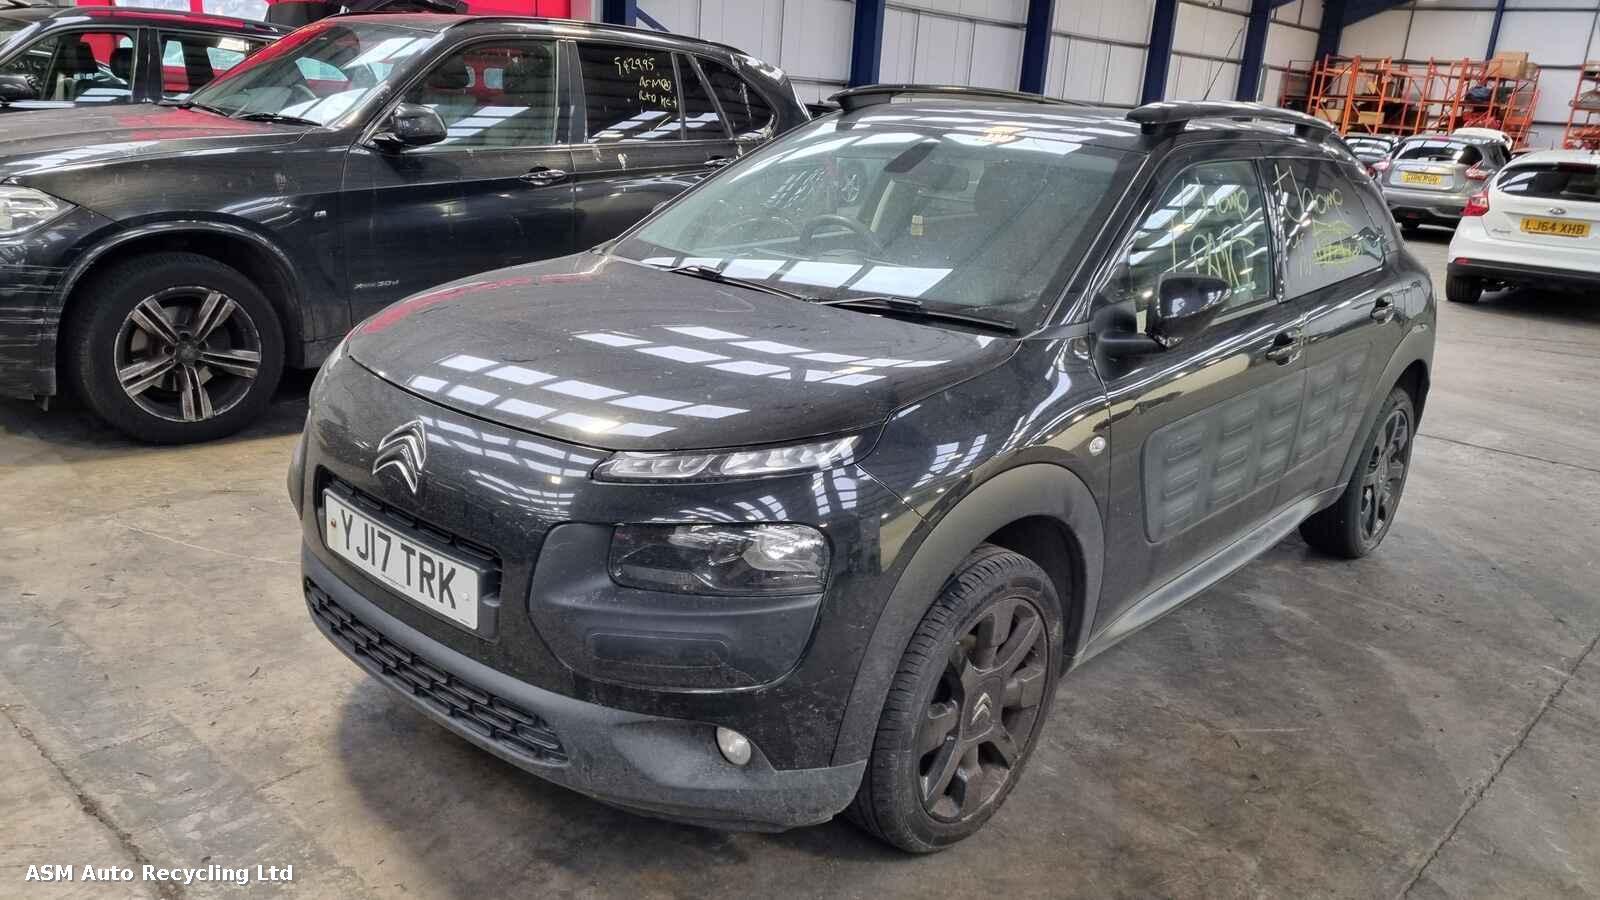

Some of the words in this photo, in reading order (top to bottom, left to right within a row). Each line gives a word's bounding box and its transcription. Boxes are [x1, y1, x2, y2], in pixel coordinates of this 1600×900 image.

[1560, 222, 1585, 235] XHB
[340, 509, 392, 573] YJ17
[400, 542, 457, 610] TRK
